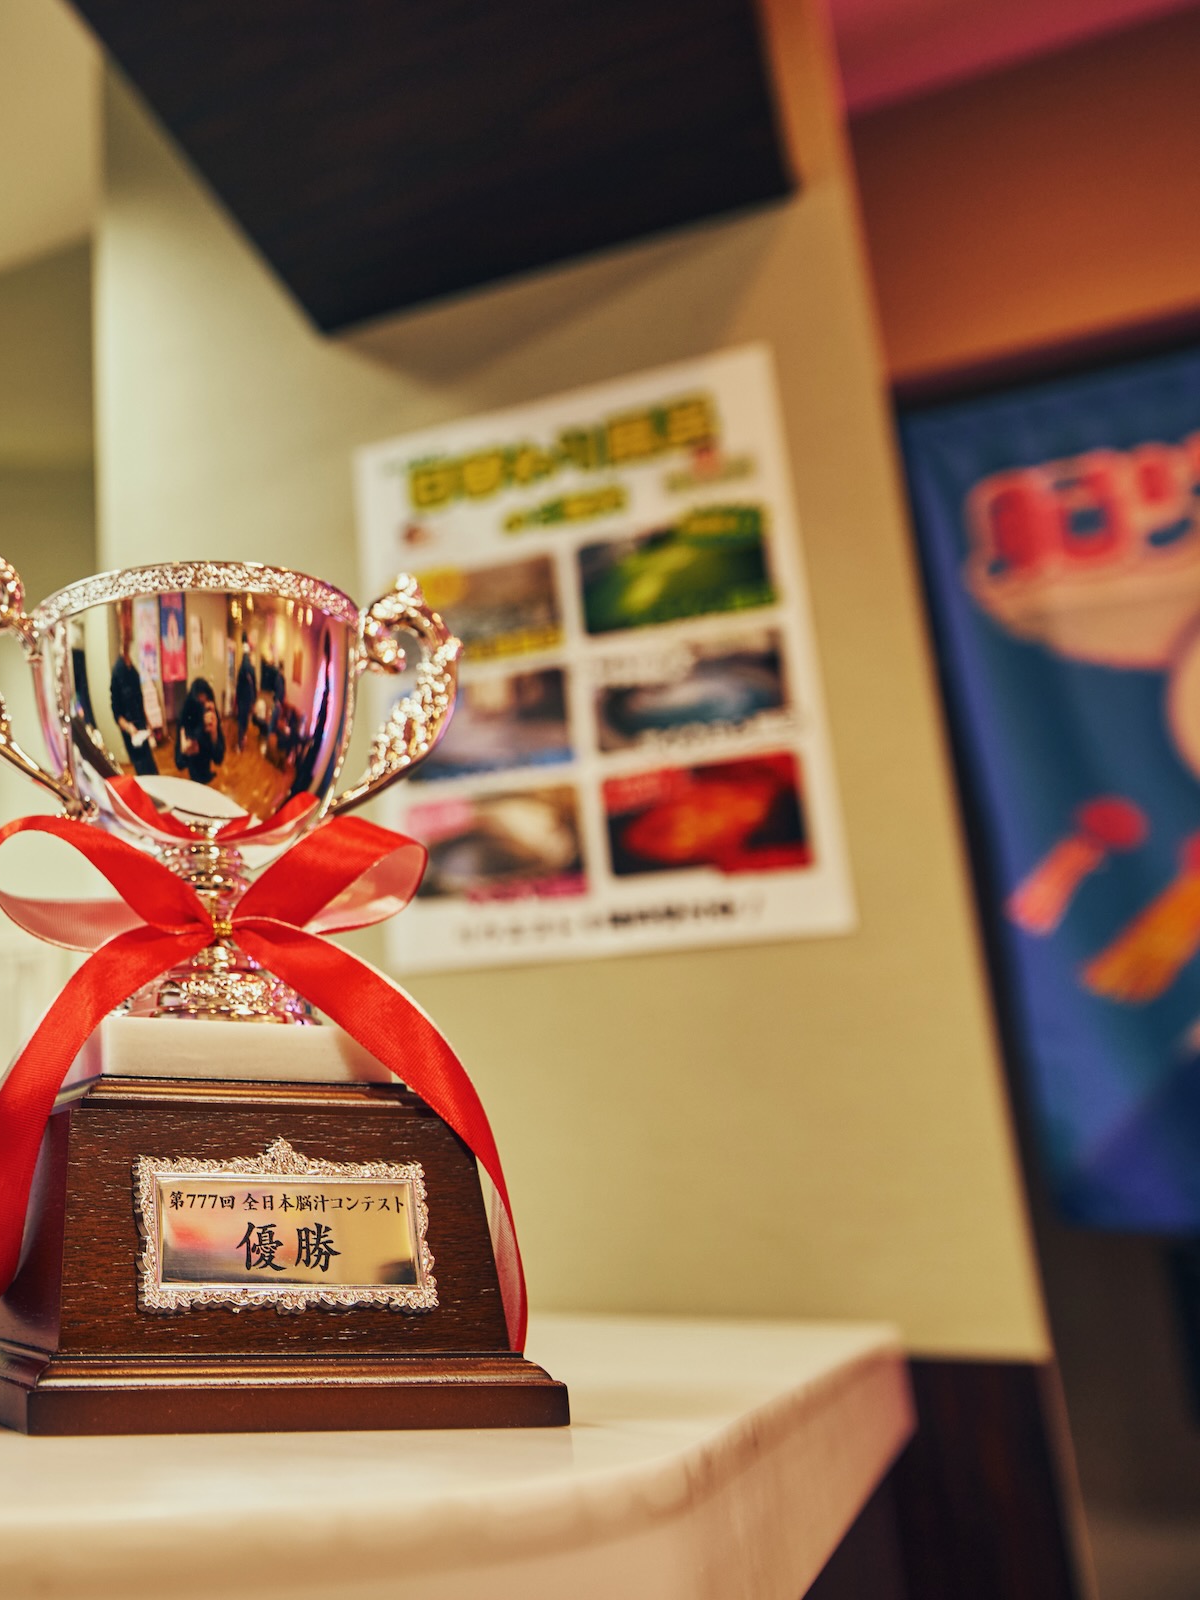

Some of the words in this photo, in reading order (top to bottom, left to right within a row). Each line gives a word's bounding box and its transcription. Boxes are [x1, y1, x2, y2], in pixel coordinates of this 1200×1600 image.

[169, 1190, 236, 1211] 第777回
[242, 1192, 406, 1214] 全日本脳汁コンテスト
[236, 1221, 342, 1273] 優勝
